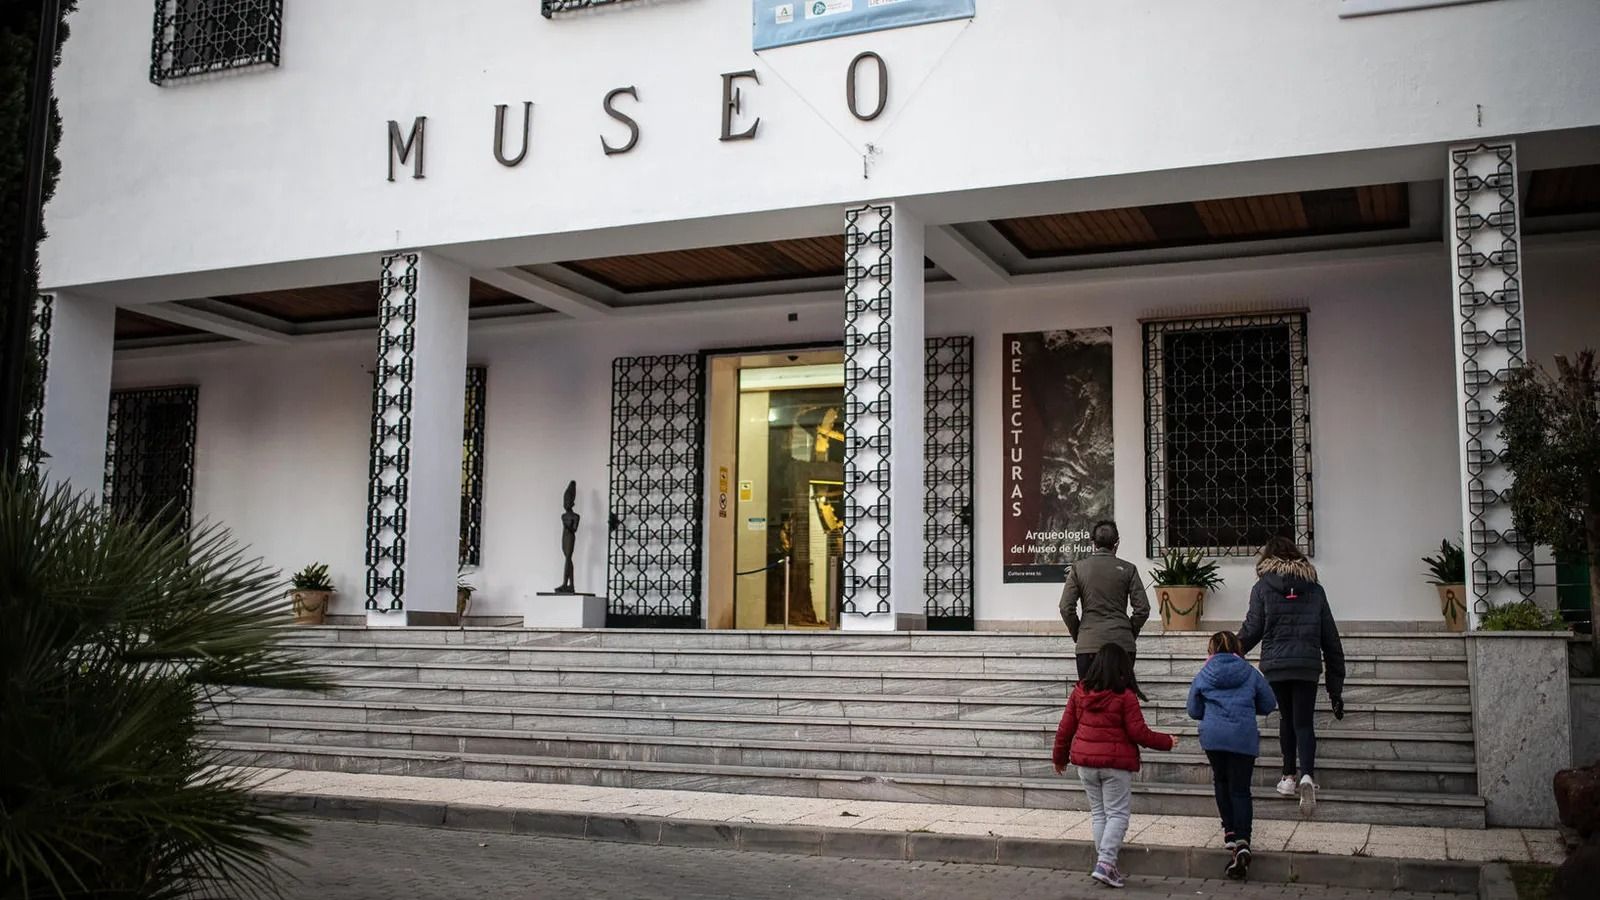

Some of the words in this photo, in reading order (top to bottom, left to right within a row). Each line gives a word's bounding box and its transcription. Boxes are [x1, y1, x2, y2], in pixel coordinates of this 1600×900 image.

[387, 50, 889, 182] MUSEO
[1011, 341, 1022, 517] RELECTURAS
[1011, 545, 1025, 553] del
[1027, 544, 1057, 553] Museo
[1060, 544, 1071, 553] de
[1073, 543, 1099, 553] Huel
[1025, 529, 1090, 541] Arqueología
